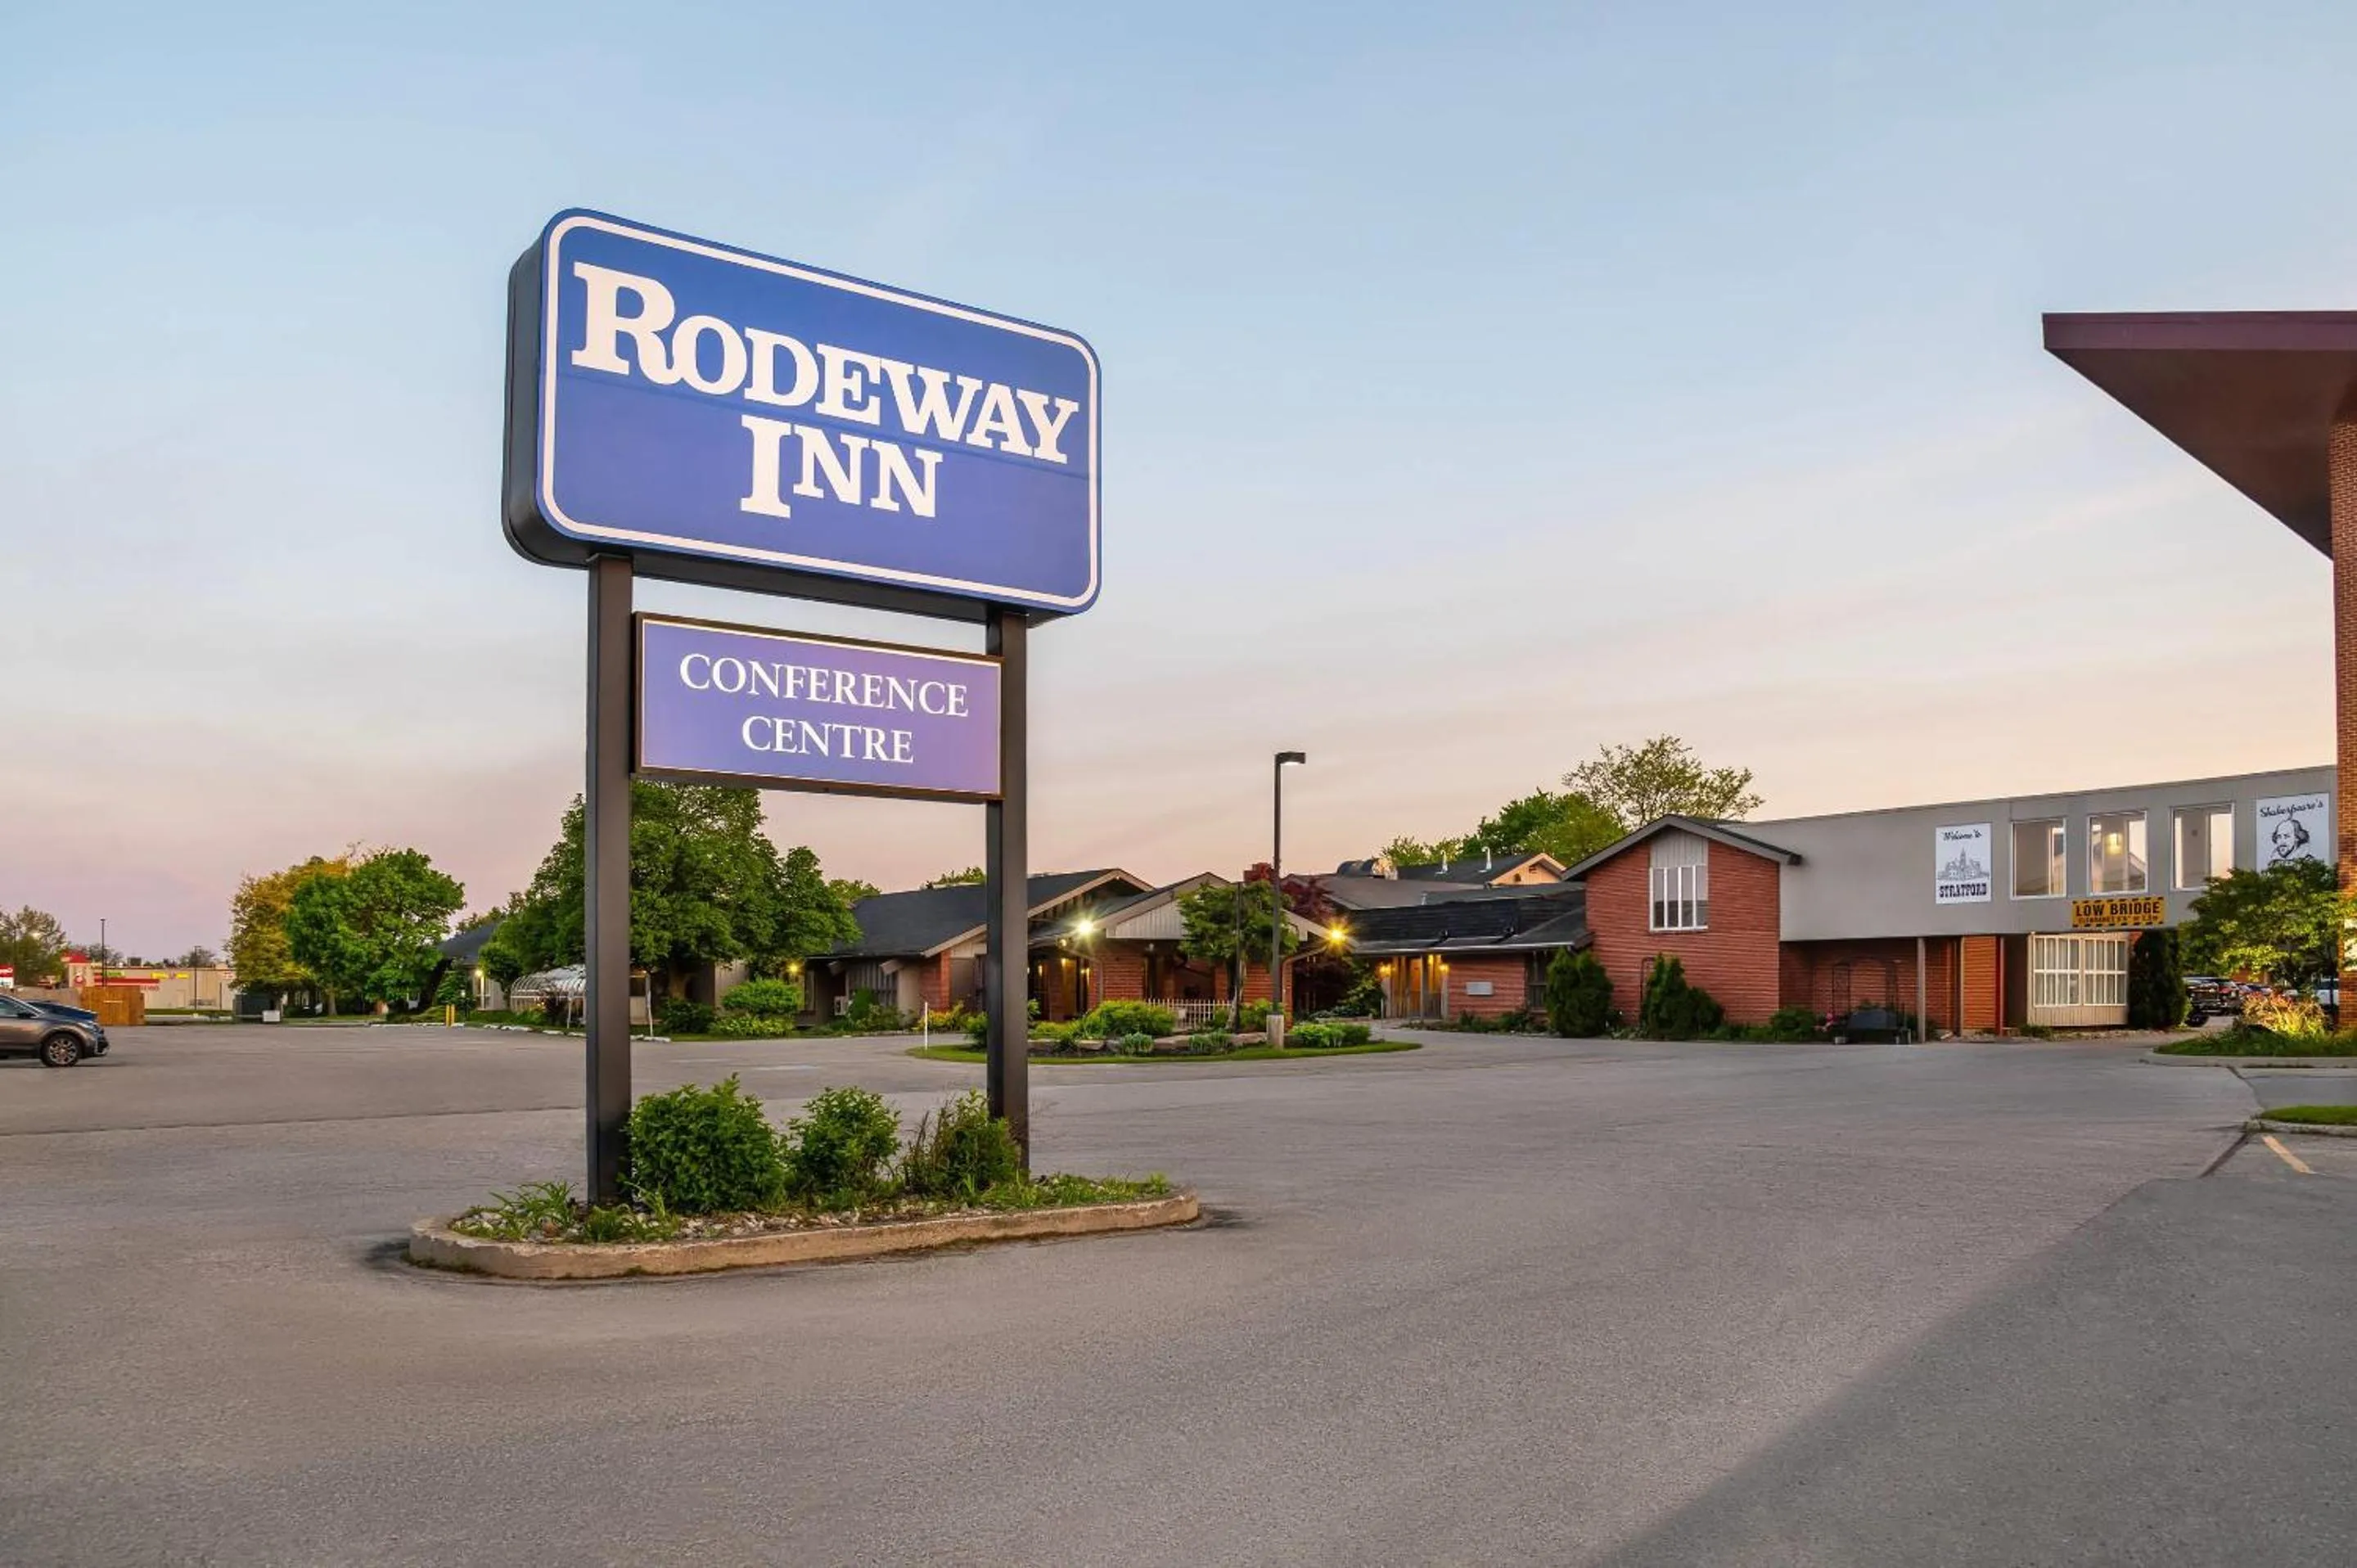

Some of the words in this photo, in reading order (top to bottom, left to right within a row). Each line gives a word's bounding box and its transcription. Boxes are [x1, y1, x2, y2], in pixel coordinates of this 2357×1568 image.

[572, 262, 1079, 464] RODEWAY
[741, 415, 943, 518] INN
[679, 653, 969, 718] CONFERENCE
[741, 715, 914, 764] CENTRE
[1939, 883, 1987, 898] STRATFORD
[2075, 904, 2105, 917] LOW
[2110, 901, 2161, 915] BRIDGE
